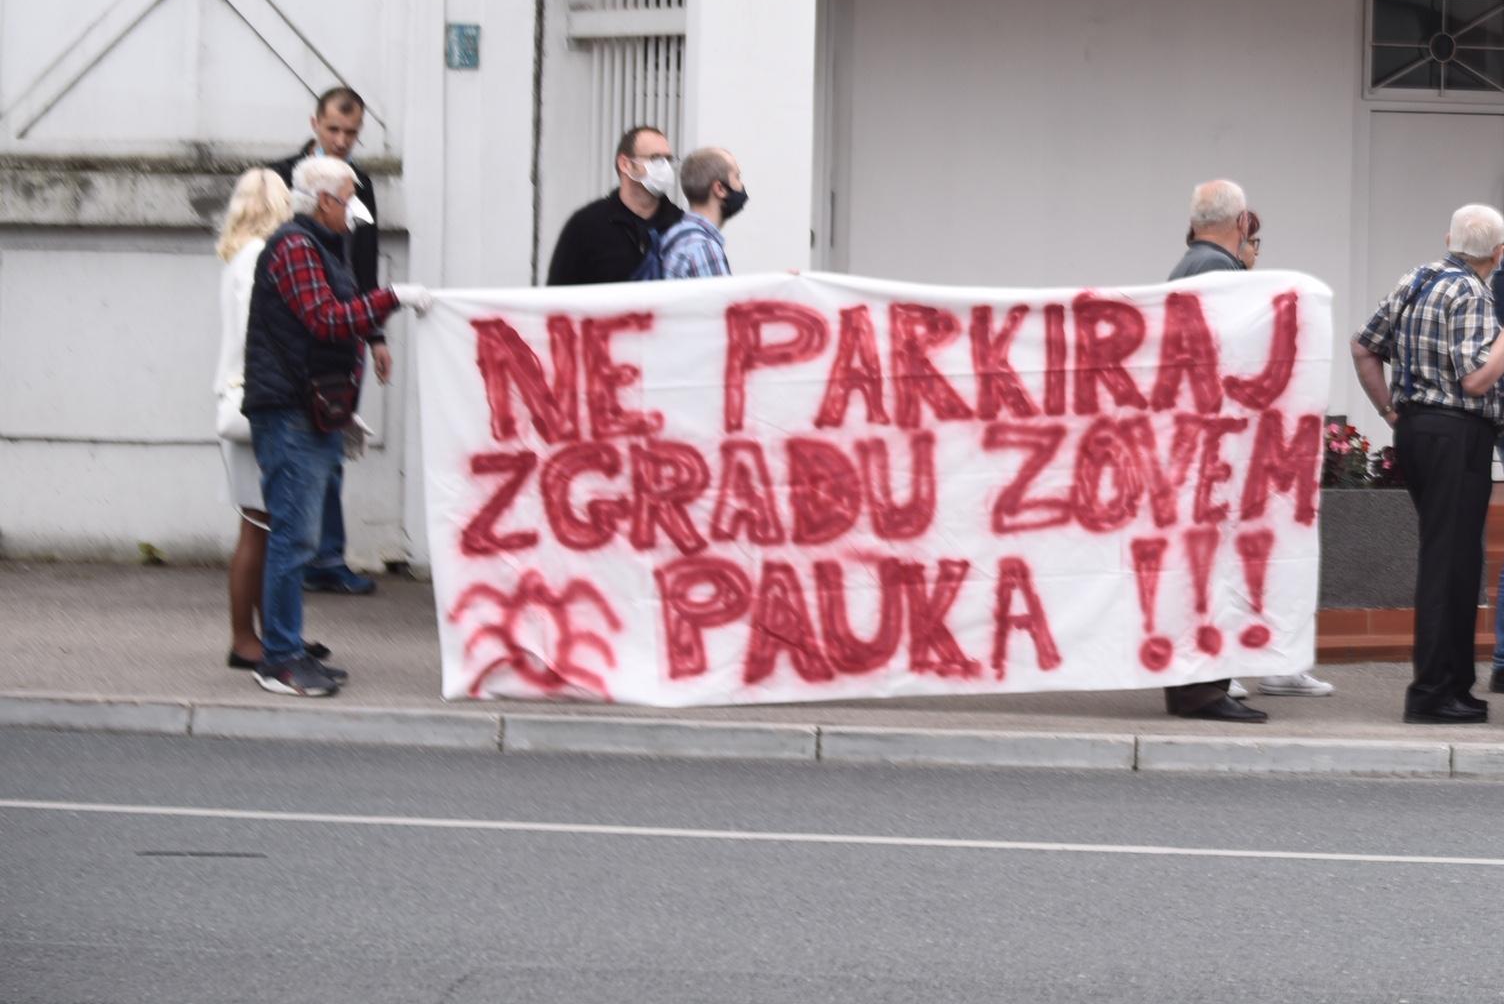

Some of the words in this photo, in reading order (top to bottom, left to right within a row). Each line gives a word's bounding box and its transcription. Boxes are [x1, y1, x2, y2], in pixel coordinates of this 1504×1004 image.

[468, 309, 666, 446] NE
[722, 290, 1300, 430] PARKIRAJ
[459, 432, 936, 555] ZGRADU
[982, 410, 1322, 534] ZOVEM
[654, 553, 1062, 682] PAUKA
